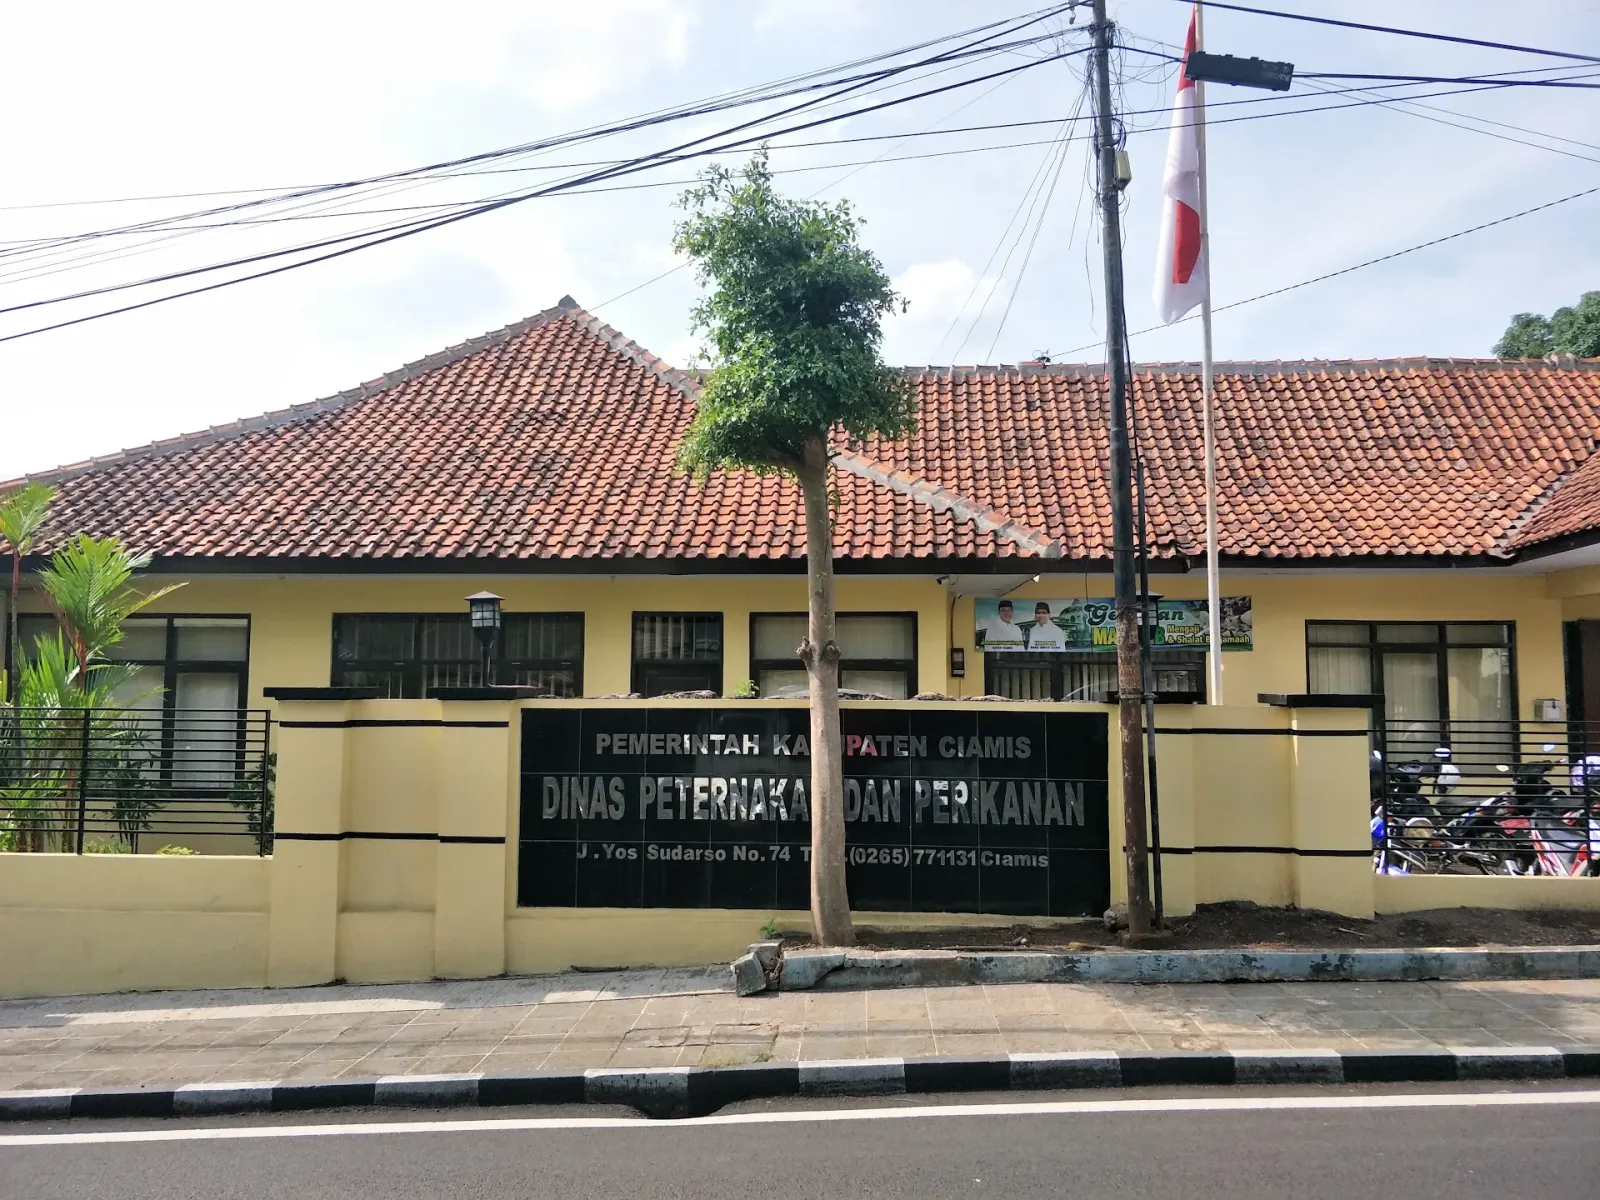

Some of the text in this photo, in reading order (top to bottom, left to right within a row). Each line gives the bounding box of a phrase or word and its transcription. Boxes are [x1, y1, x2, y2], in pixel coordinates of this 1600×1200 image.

[1167, 624, 1200, 634] Mengaji
[1168, 635, 1175, 644] &
[1177, 635, 1203, 644] Shalat
[596, 733, 1032, 759] PEMERINTAH KAPATEN CIAMIS
[542, 776, 1085, 826] DINAS PETERNAKA DAN PERIKANAN
[646, 844, 726, 862] Sudarso
[912, 849, 977, 867] 771131
